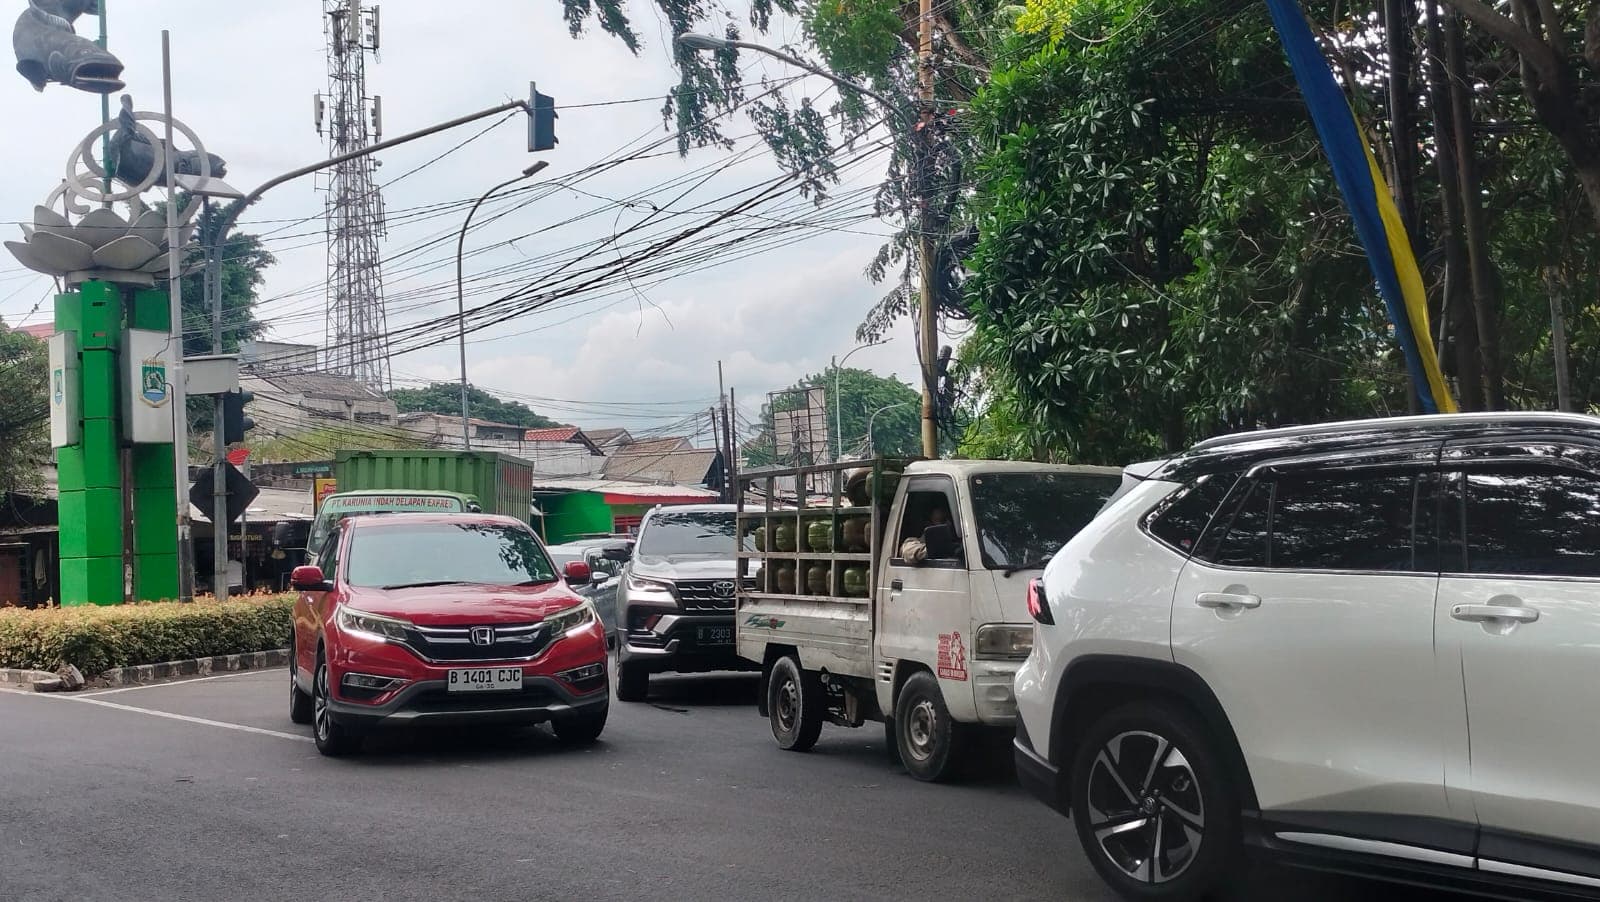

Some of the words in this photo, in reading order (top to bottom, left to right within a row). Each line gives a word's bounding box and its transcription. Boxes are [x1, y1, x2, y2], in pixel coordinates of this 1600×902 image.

[342, 497, 371, 507] KARUNIA
[374, 496, 394, 506] INDAH
[396, 497, 425, 507] DELAPAN
[450, 671, 458, 684] B
[463, 670, 492, 684] 1401
[498, 669, 520, 682] CJC
